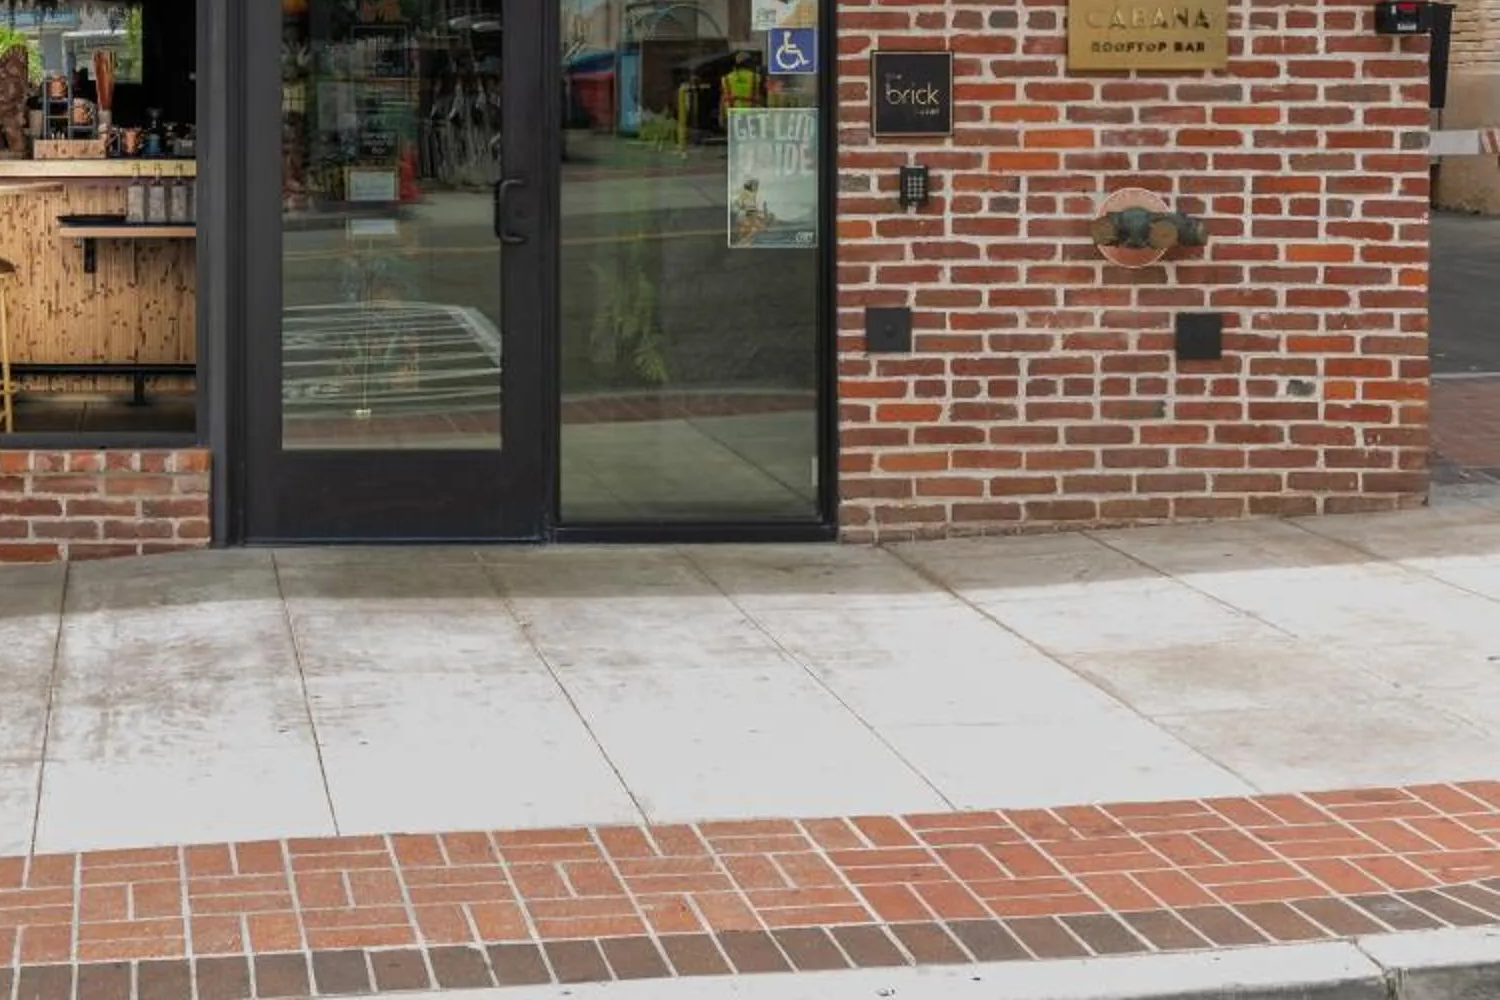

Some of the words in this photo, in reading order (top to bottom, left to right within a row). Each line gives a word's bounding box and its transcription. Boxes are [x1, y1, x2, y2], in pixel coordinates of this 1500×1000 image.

[1091, 41, 1167, 53] ROOFTOP
[1174, 41, 1205, 53] BAR
[885, 81, 940, 105] brick
[733, 113, 769, 140] GET
